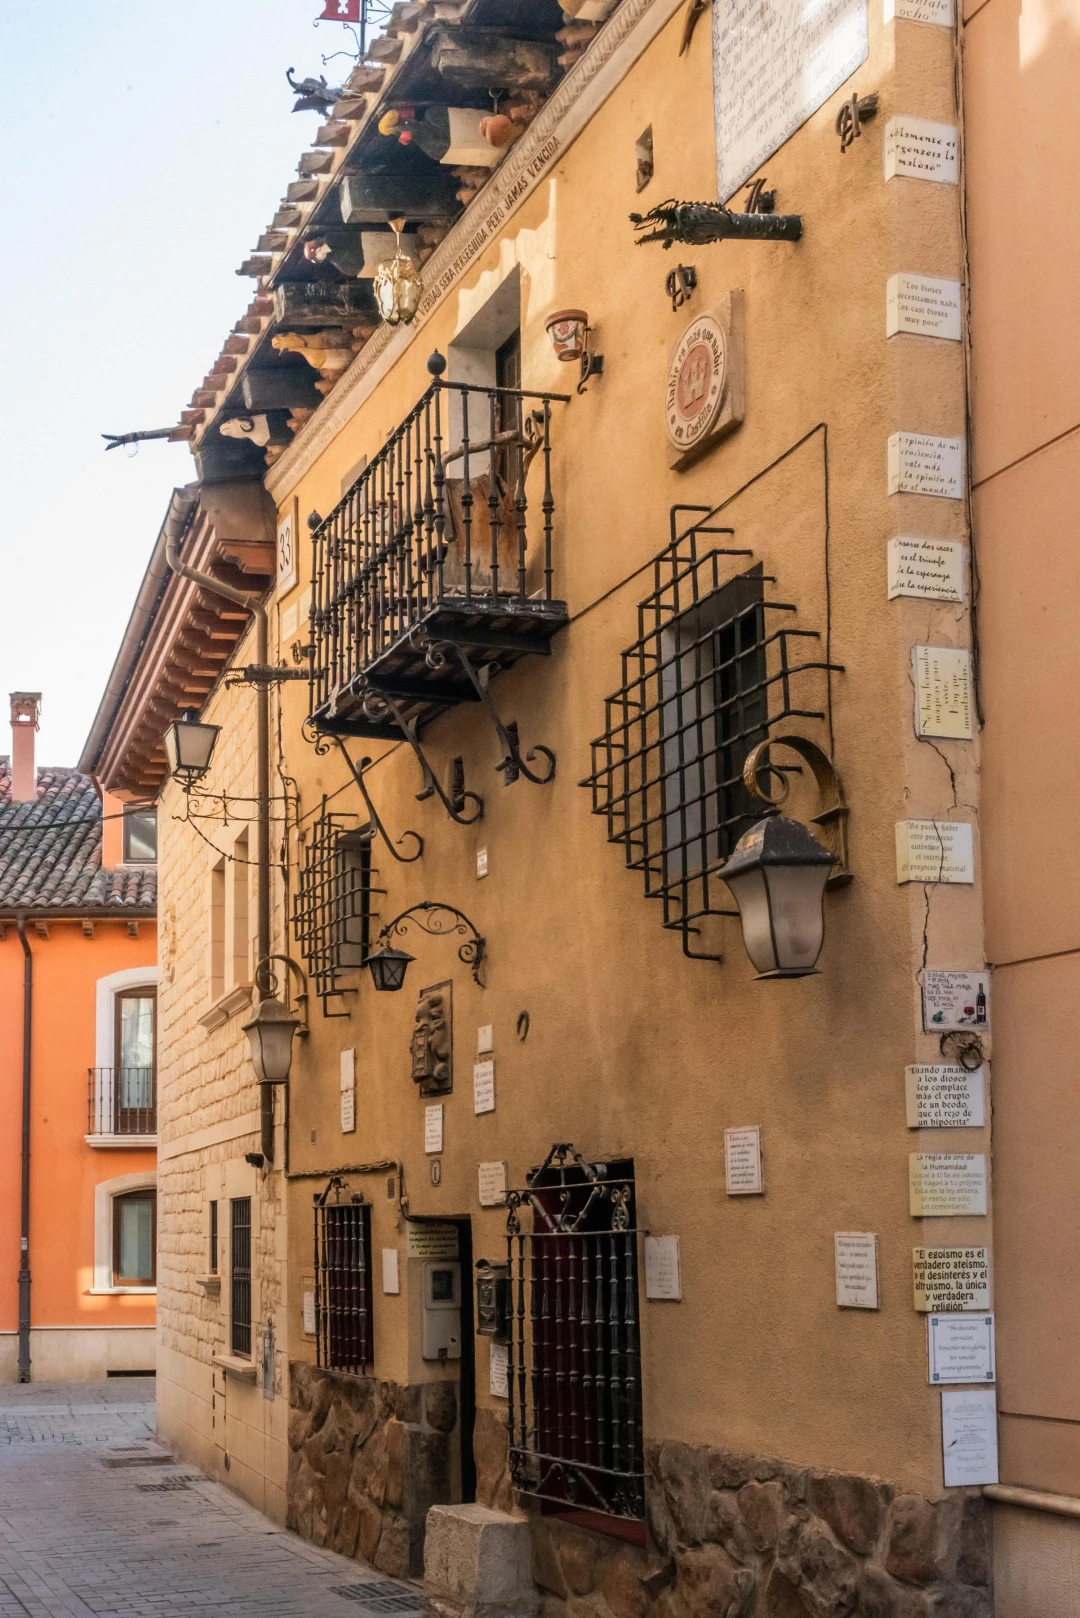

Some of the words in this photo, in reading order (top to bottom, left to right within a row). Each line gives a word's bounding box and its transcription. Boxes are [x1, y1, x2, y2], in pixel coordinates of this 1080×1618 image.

[946, 150, 955, 160] la
[418, 285, 442, 317] VERDAD
[440, 268, 457, 291] SERA
[454, 228, 490, 275] PERSEGUIDA
[486, 206, 505, 234] PERO
[505, 176, 529, 211] JAMAS
[527, 135, 562, 179] VENCIDA
[920, 284, 942, 294] dioses
[911, 306, 925, 314] casi
[927, 308, 948, 317] dioses
[905, 316, 920, 325] muy
[711, 337, 723, 376] nadie
[905, 438, 935, 448] opinión
[938, 441, 946, 449] de
[905, 461, 921, 469] vale
[904, 471, 913, 479] la
[916, 474, 944, 483] opinión
[279, 526, 291, 572] 33
[894, 538, 920, 548] Casarse
[921, 541, 935, 550] dos
[909, 552, 917, 561] el
[918, 555, 946, 568] triunfo
[906, 566, 915, 575] la
[916, 570, 951, 582] esperanza
[907, 580, 916, 589] la
[919, 648, 930, 689] fórmulas
[933, 660, 942, 681] para
[952, 673, 960, 690] que
[921, 693, 933, 711] hay
[934, 685, 942, 723] mágicas
[949, 693, 960, 714] Hay
[941, 824, 958, 832] haber
[910, 833, 924, 841] otro
[925, 1074, 938, 1082] los
[940, 1074, 967, 1083] dioses
[917, 1083, 929, 1091] les
[931, 1083, 968, 1092] complace
[915, 1092, 932, 1100] más
[934, 1091, 942, 1100] el
[944, 1093, 970, 1101] erupto
[917, 1100, 927, 1108] de
[941, 1100, 969, 1109] beodo,
[917, 1110, 932, 1118] que
[934, 1109, 942, 1117] el
[962, 1109, 972, 1117] de
[924, 1153, 942, 1162] regla
[927, 1248, 963, 1259] egoísmo
[965, 1250, 975, 1259] es
[977, 1248, 985, 1259] el
[913, 1260, 951, 1270] verdadero
[914, 1272, 919, 1280] y
[919, 1271, 926, 1280] el
[928, 1270, 971, 1280] desinterés
[972, 1272, 978, 1280] y
[980, 1270, 987, 1279] el
[956, 1280, 963, 1290] la
[965, 1280, 987, 1290] única
[925, 1293, 931, 1301] y
[932, 1291, 974, 1301] verdadera
